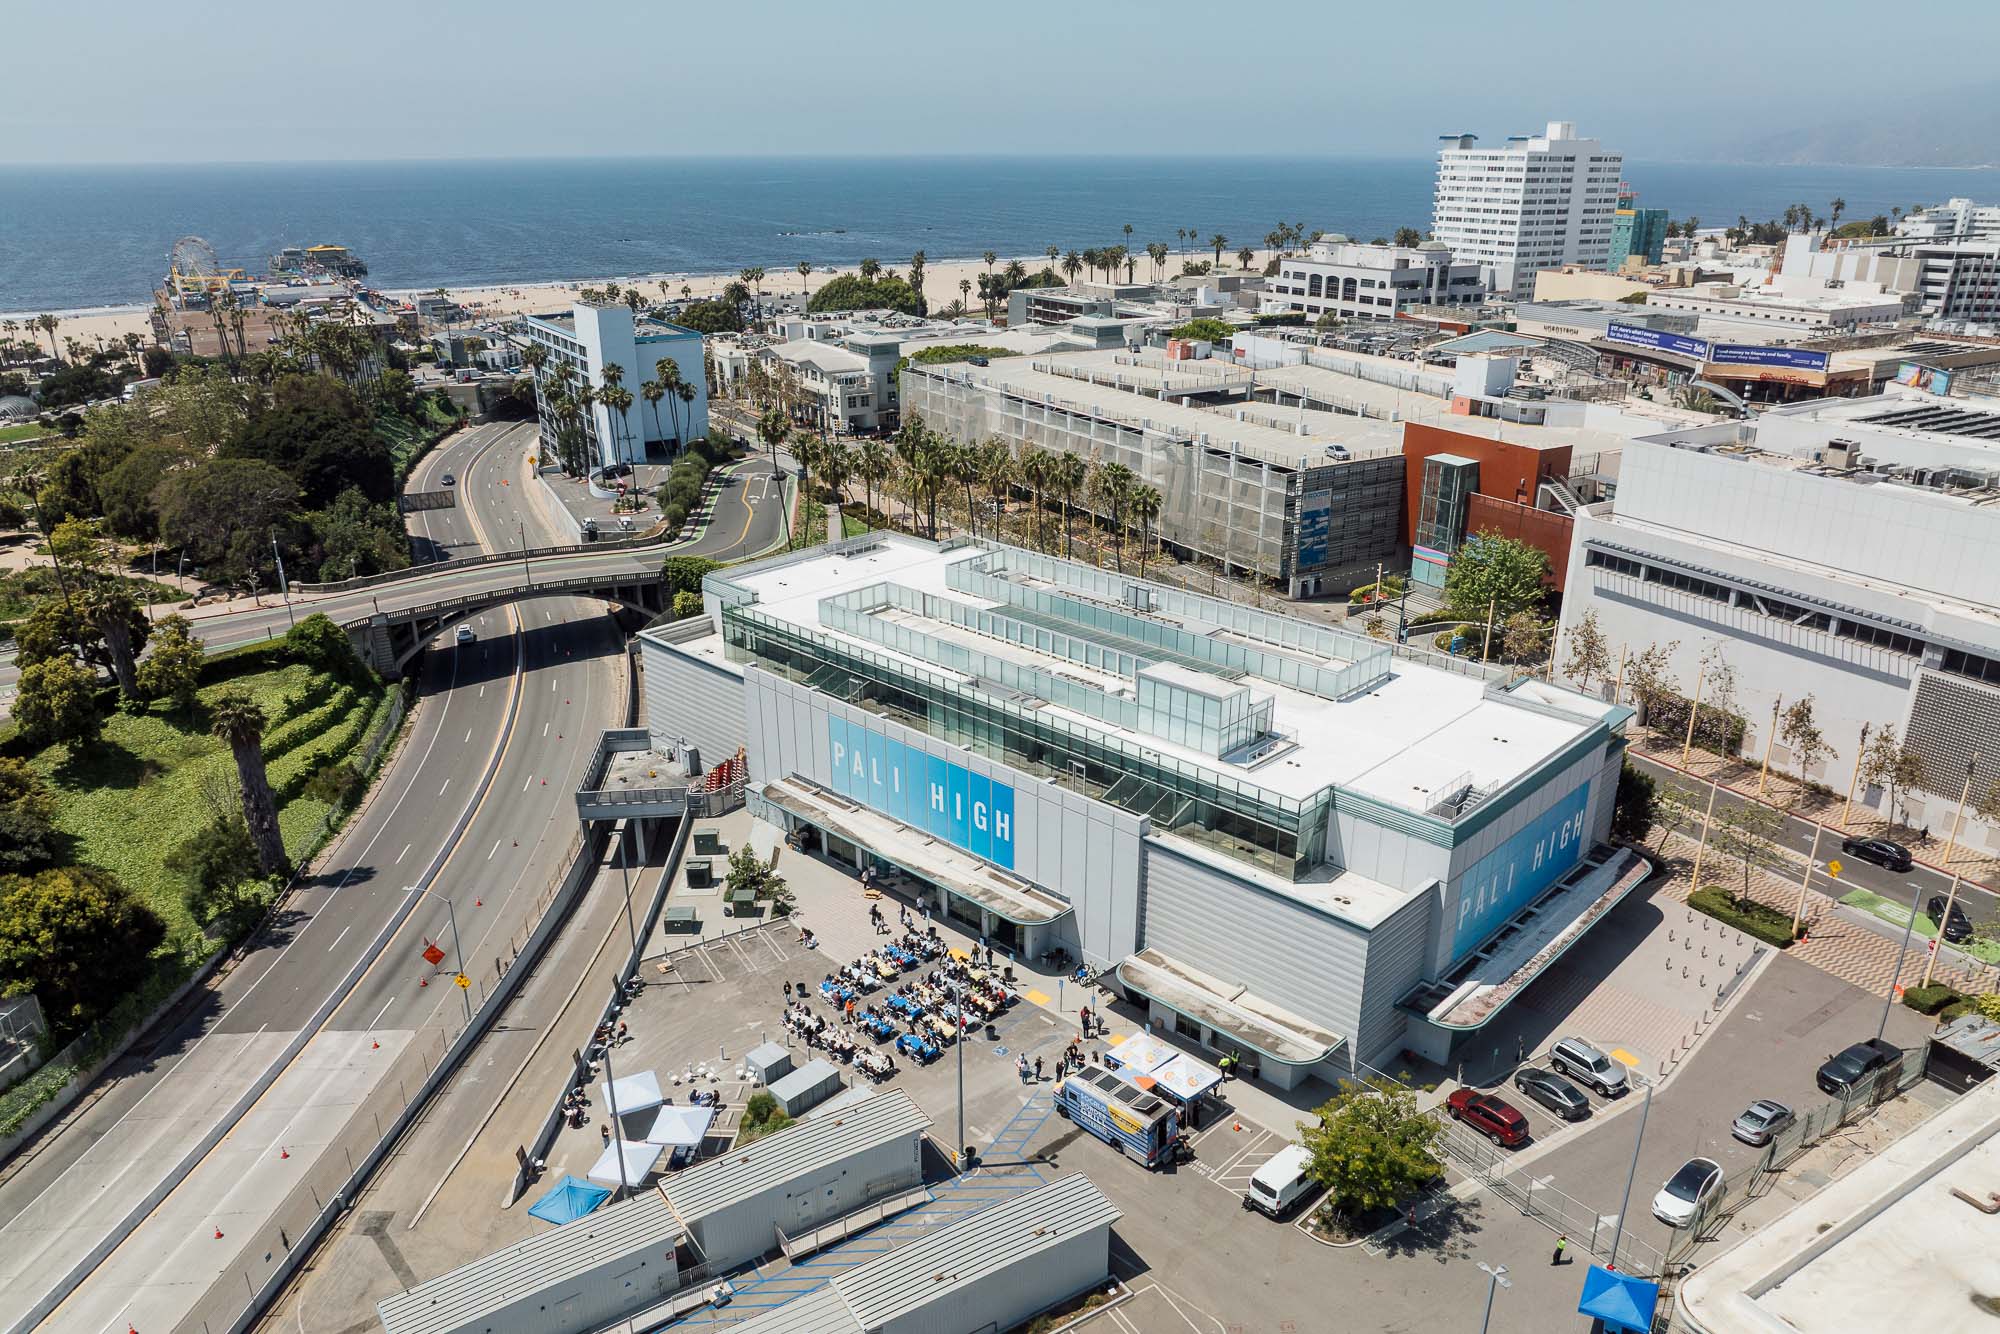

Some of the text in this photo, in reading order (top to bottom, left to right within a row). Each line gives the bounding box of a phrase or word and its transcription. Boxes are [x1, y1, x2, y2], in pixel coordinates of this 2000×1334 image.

[834, 742, 1010, 842] PALI HIGH
[1458, 809, 1584, 931] PALI HIGH
